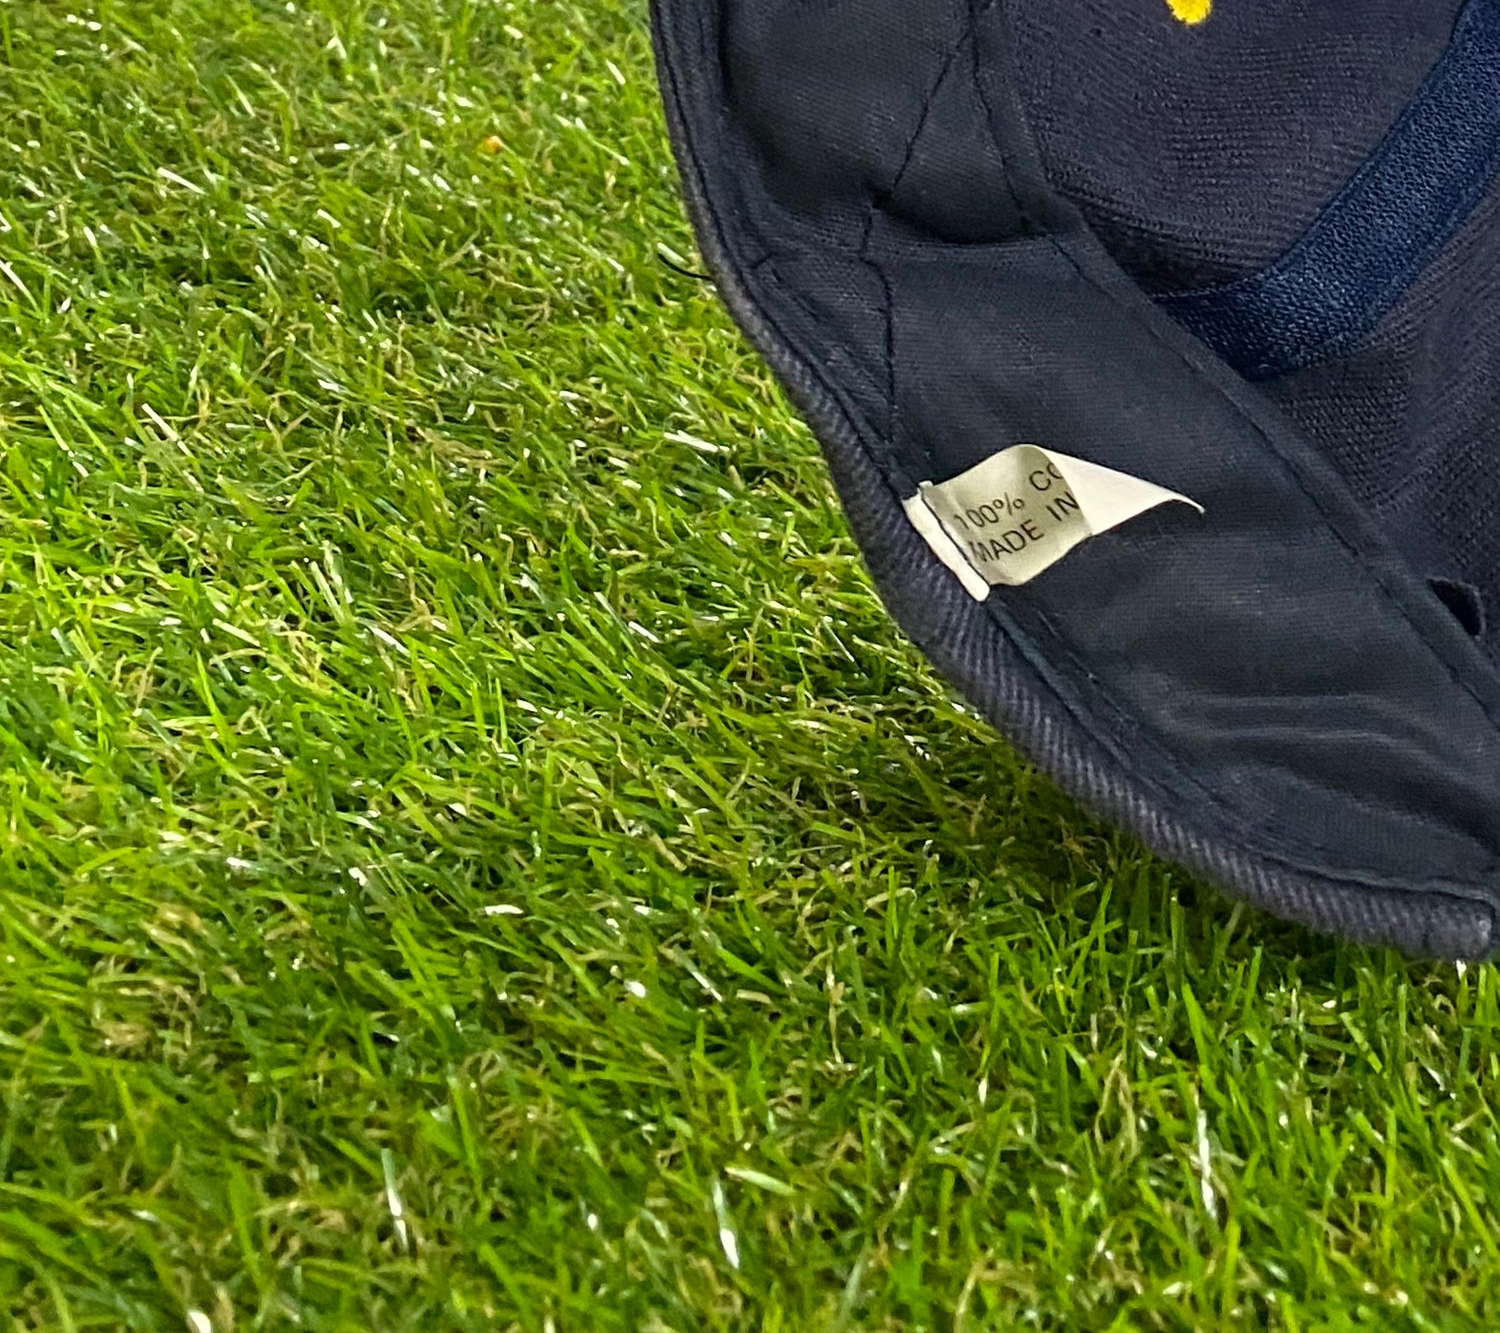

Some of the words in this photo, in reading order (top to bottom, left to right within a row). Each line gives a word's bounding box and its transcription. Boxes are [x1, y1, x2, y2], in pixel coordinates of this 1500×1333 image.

[954, 491, 1025, 530] 100%
[966, 519, 1044, 563] MADE
[1046, 491, 1080, 521] IN
